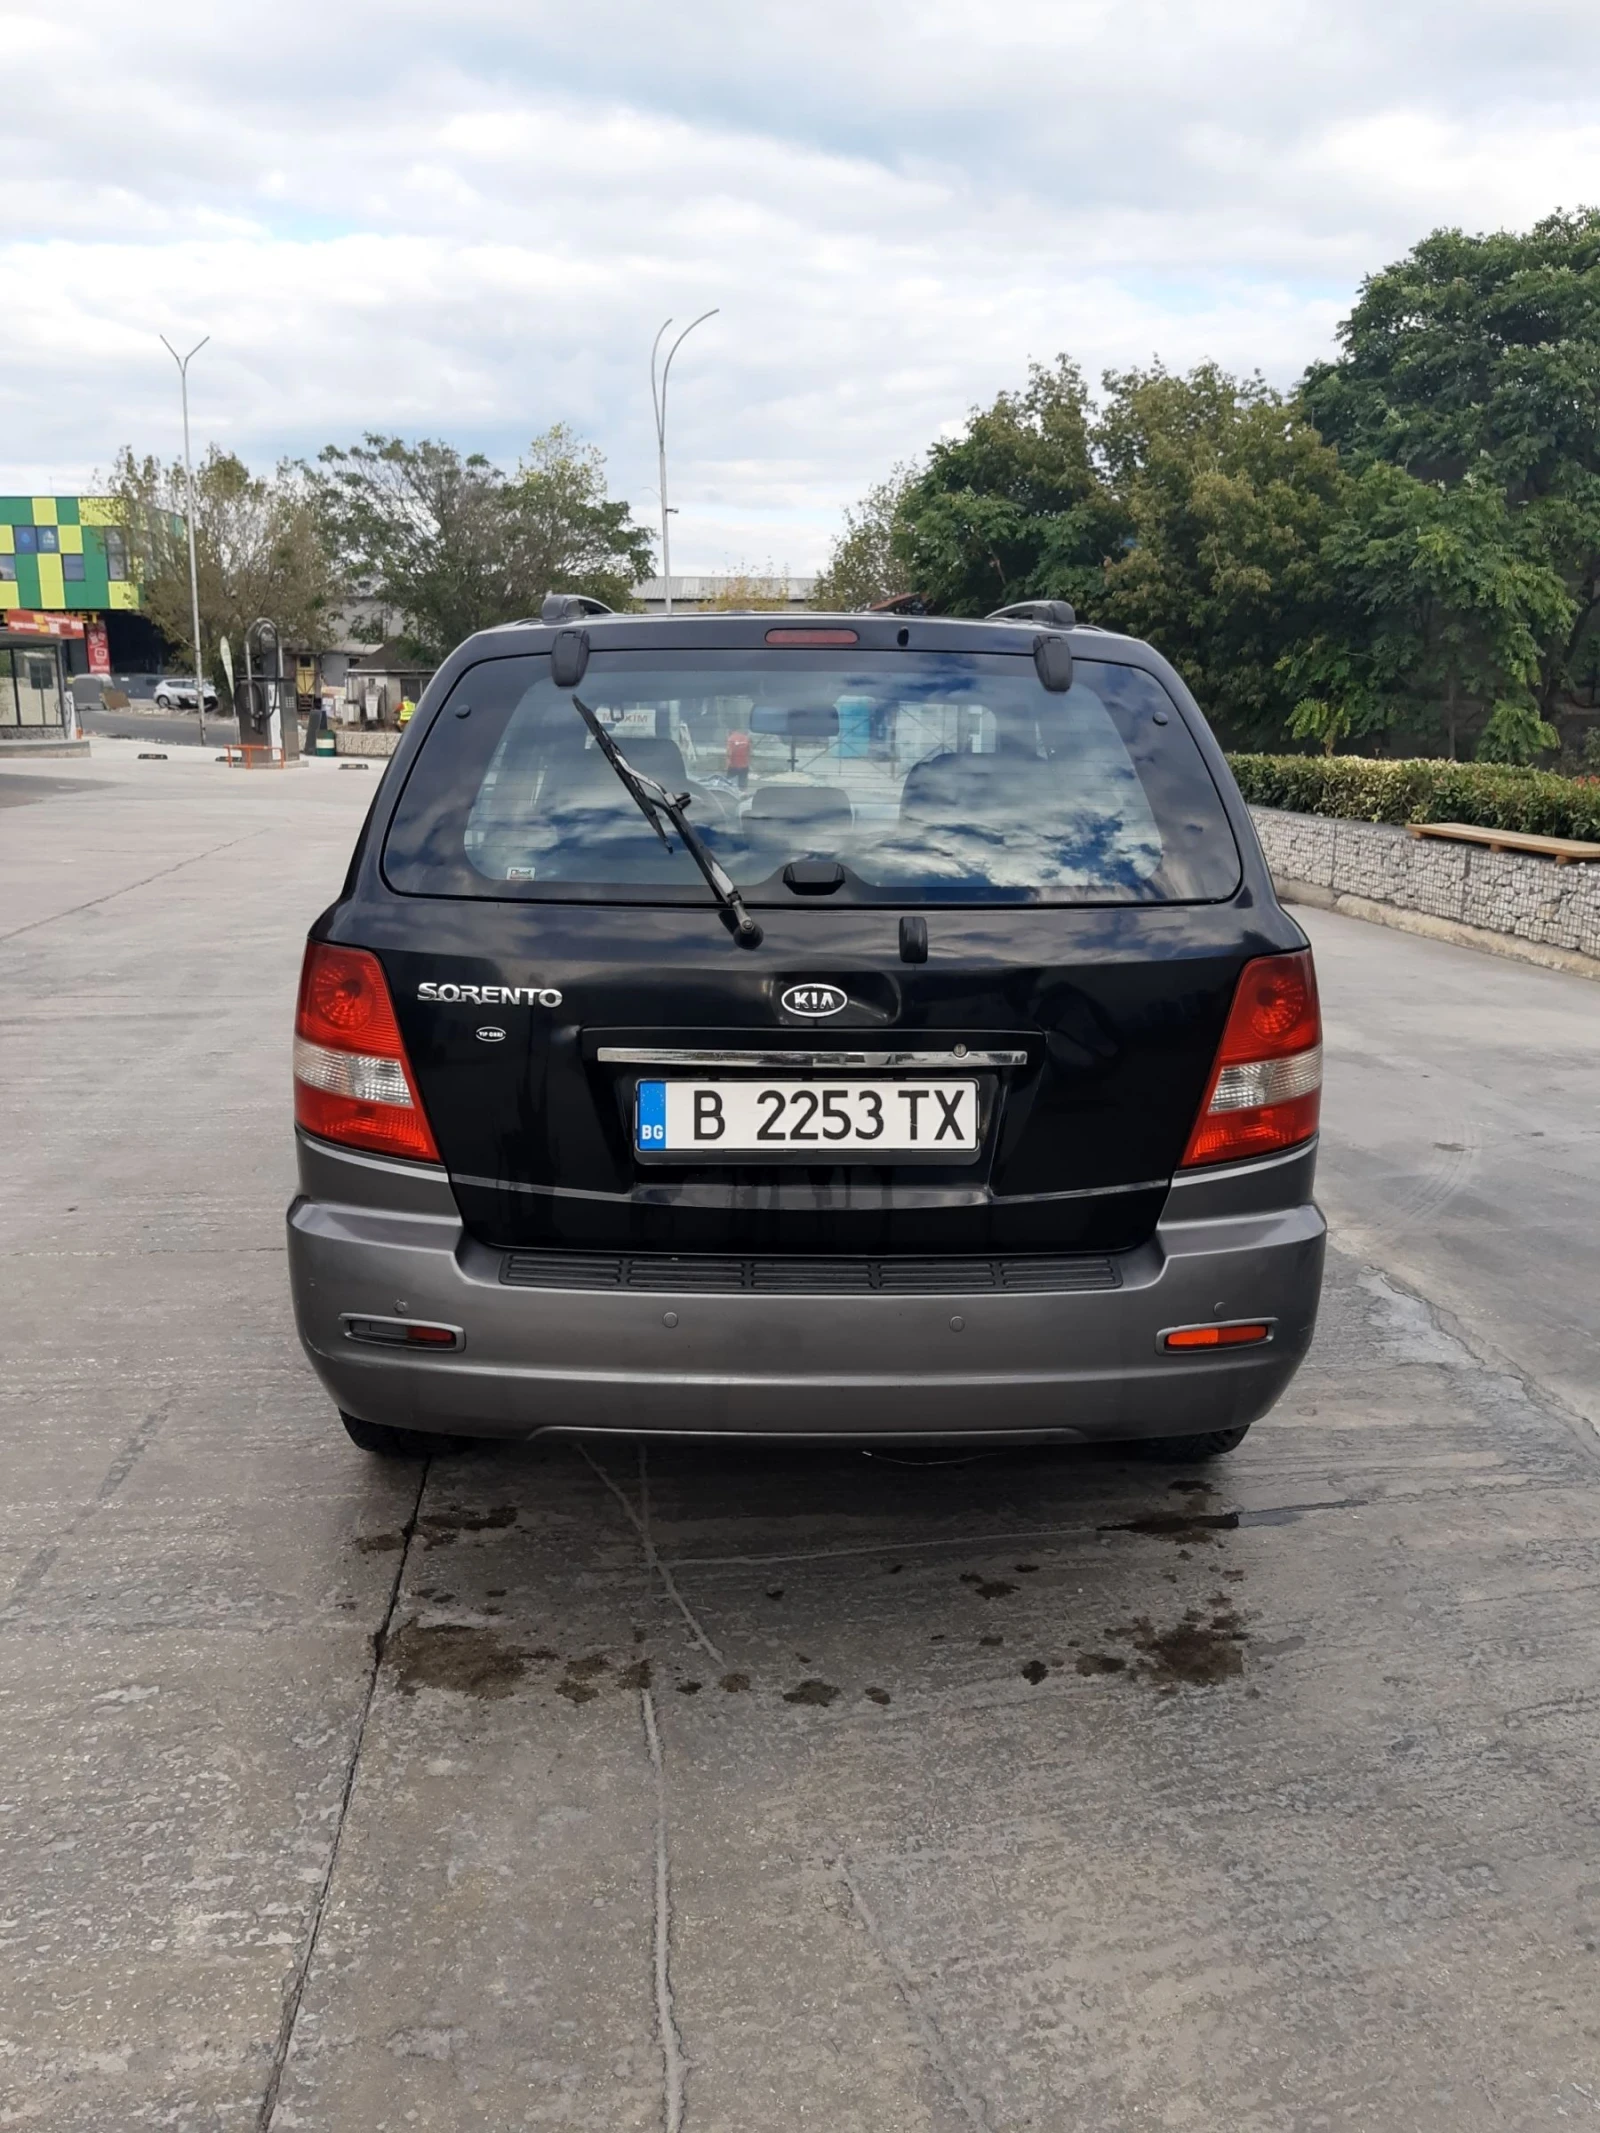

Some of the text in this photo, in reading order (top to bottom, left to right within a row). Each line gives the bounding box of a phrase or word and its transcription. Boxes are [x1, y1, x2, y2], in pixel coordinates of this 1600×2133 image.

[603, 713, 647, 723] MXIM
[417, 983, 562, 1007] SORENTO
[793, 992, 835, 1009] KIA
[693, 1090, 965, 1140] B 2253 TX
[642, 1125, 663, 1140] BG
